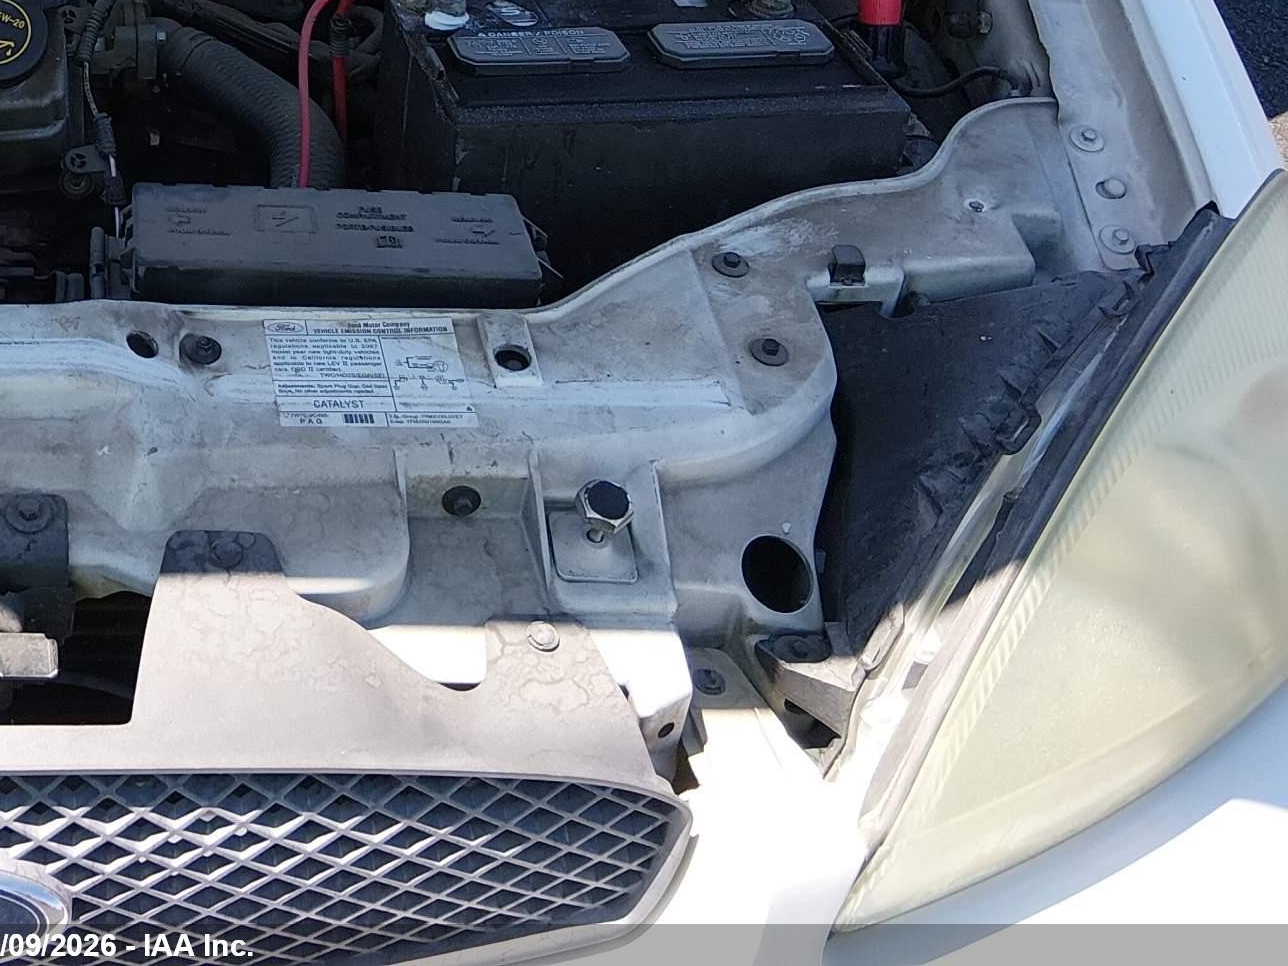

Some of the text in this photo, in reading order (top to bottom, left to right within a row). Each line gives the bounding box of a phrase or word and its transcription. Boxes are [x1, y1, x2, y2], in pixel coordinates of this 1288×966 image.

[274, 323, 296, 332] Ford
[382, 321, 409, 329] Company
[403, 326, 448, 334] INFORMATION
[313, 399, 365, 409] CATALYST
